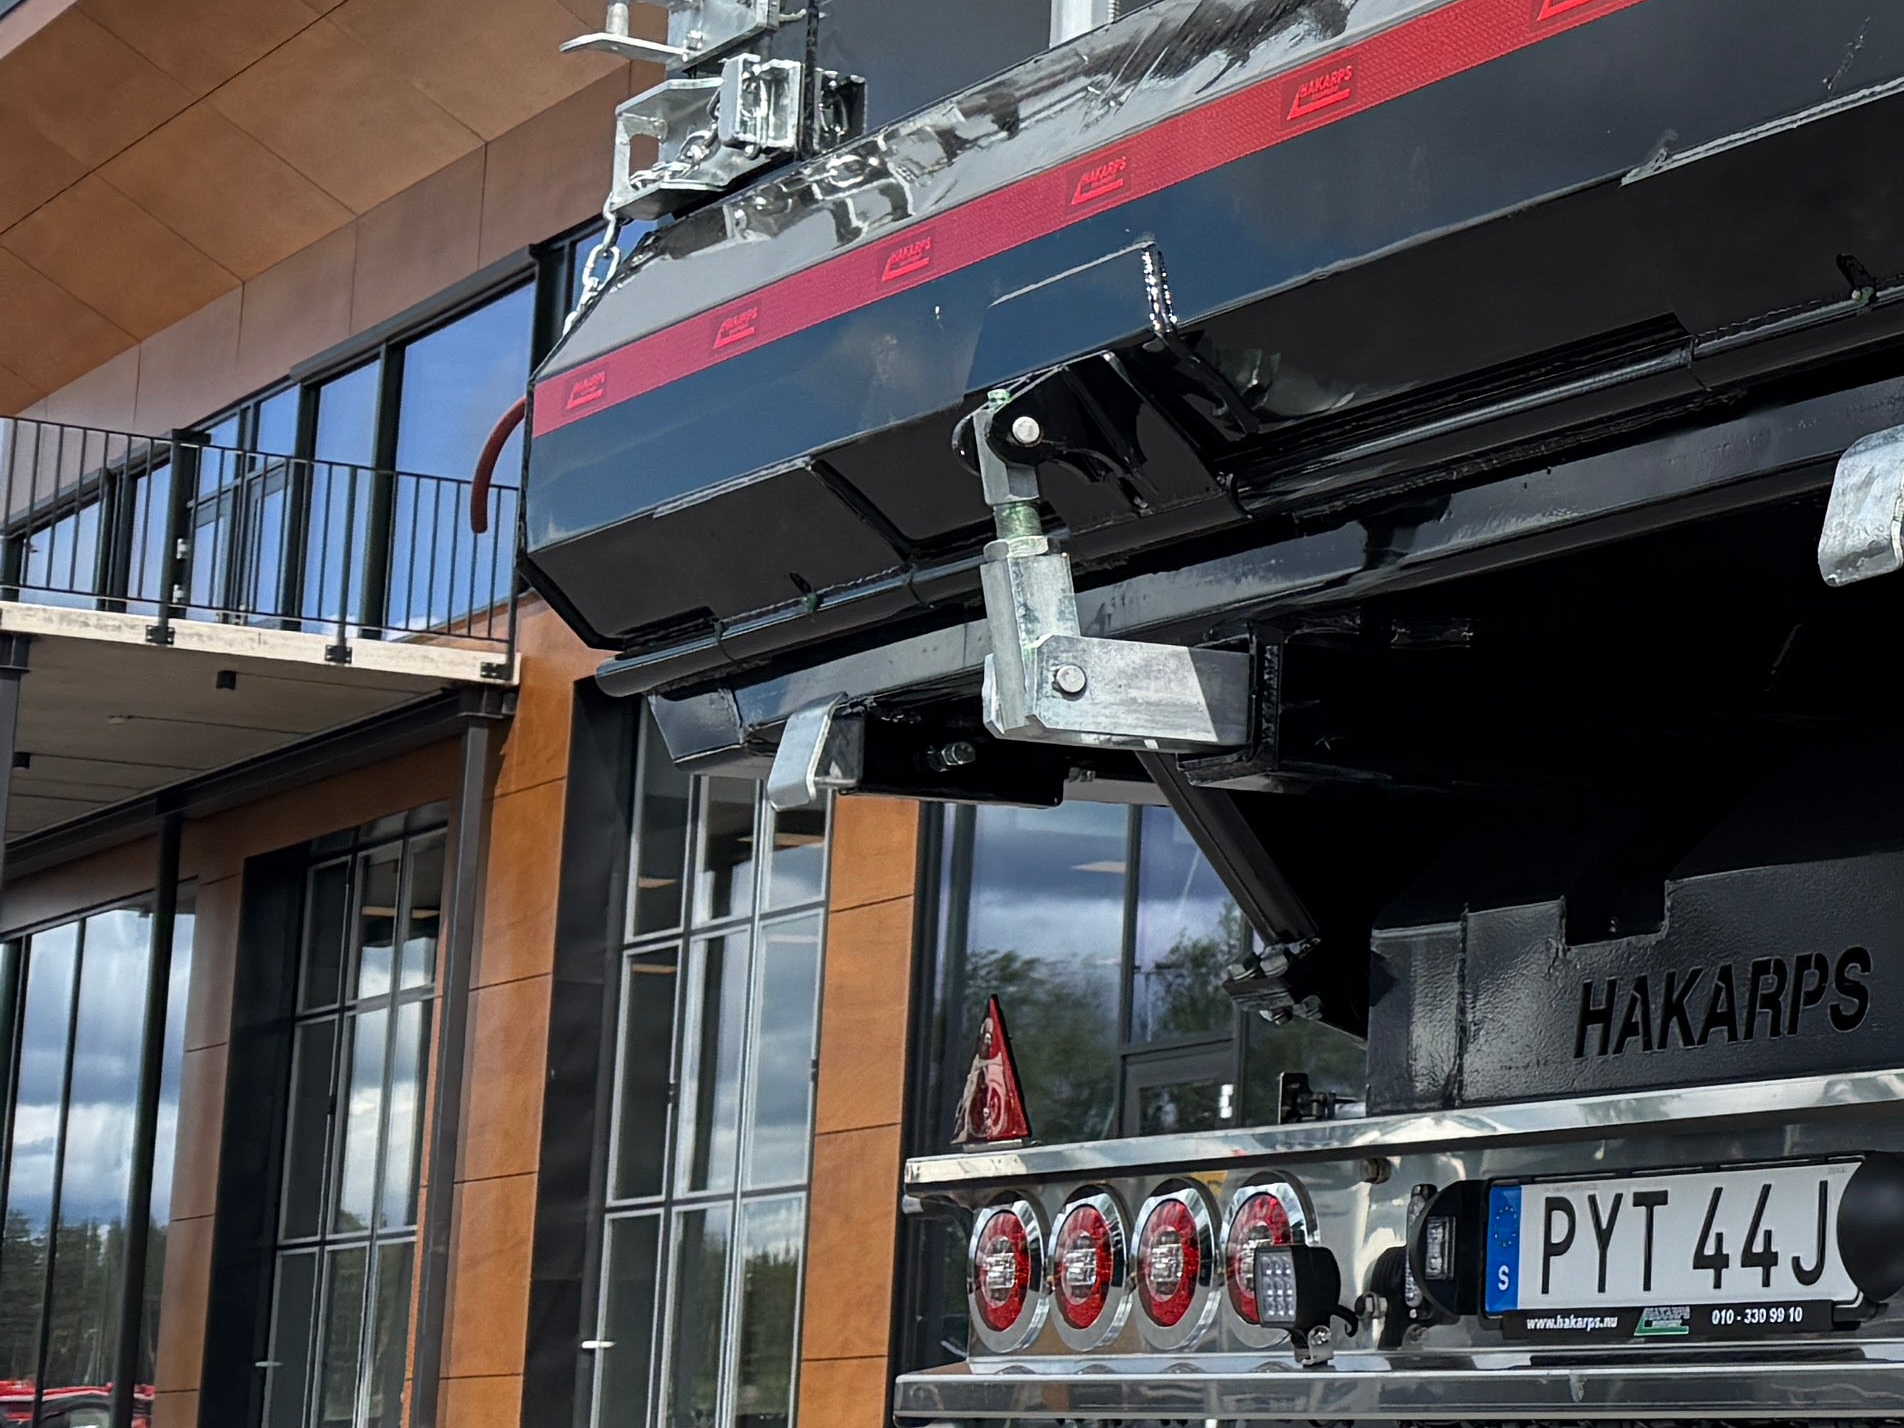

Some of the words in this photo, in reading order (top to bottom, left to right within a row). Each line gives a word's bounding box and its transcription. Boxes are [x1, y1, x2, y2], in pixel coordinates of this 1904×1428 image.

[1574, 946, 1872, 1059] HAKARPS
[1541, 1190, 1669, 1295] PYT
[1692, 1179, 1828, 1290] 44J
[1498, 1265, 1510, 1291] S
[1526, 1314, 1619, 1333] www.hakarps.nu
[1711, 1309, 1735, 1325] 010
[1743, 1307, 1767, 1324] 330
[1769, 1306, 1785, 1323] 99
[1788, 1306, 1803, 1323] 10
